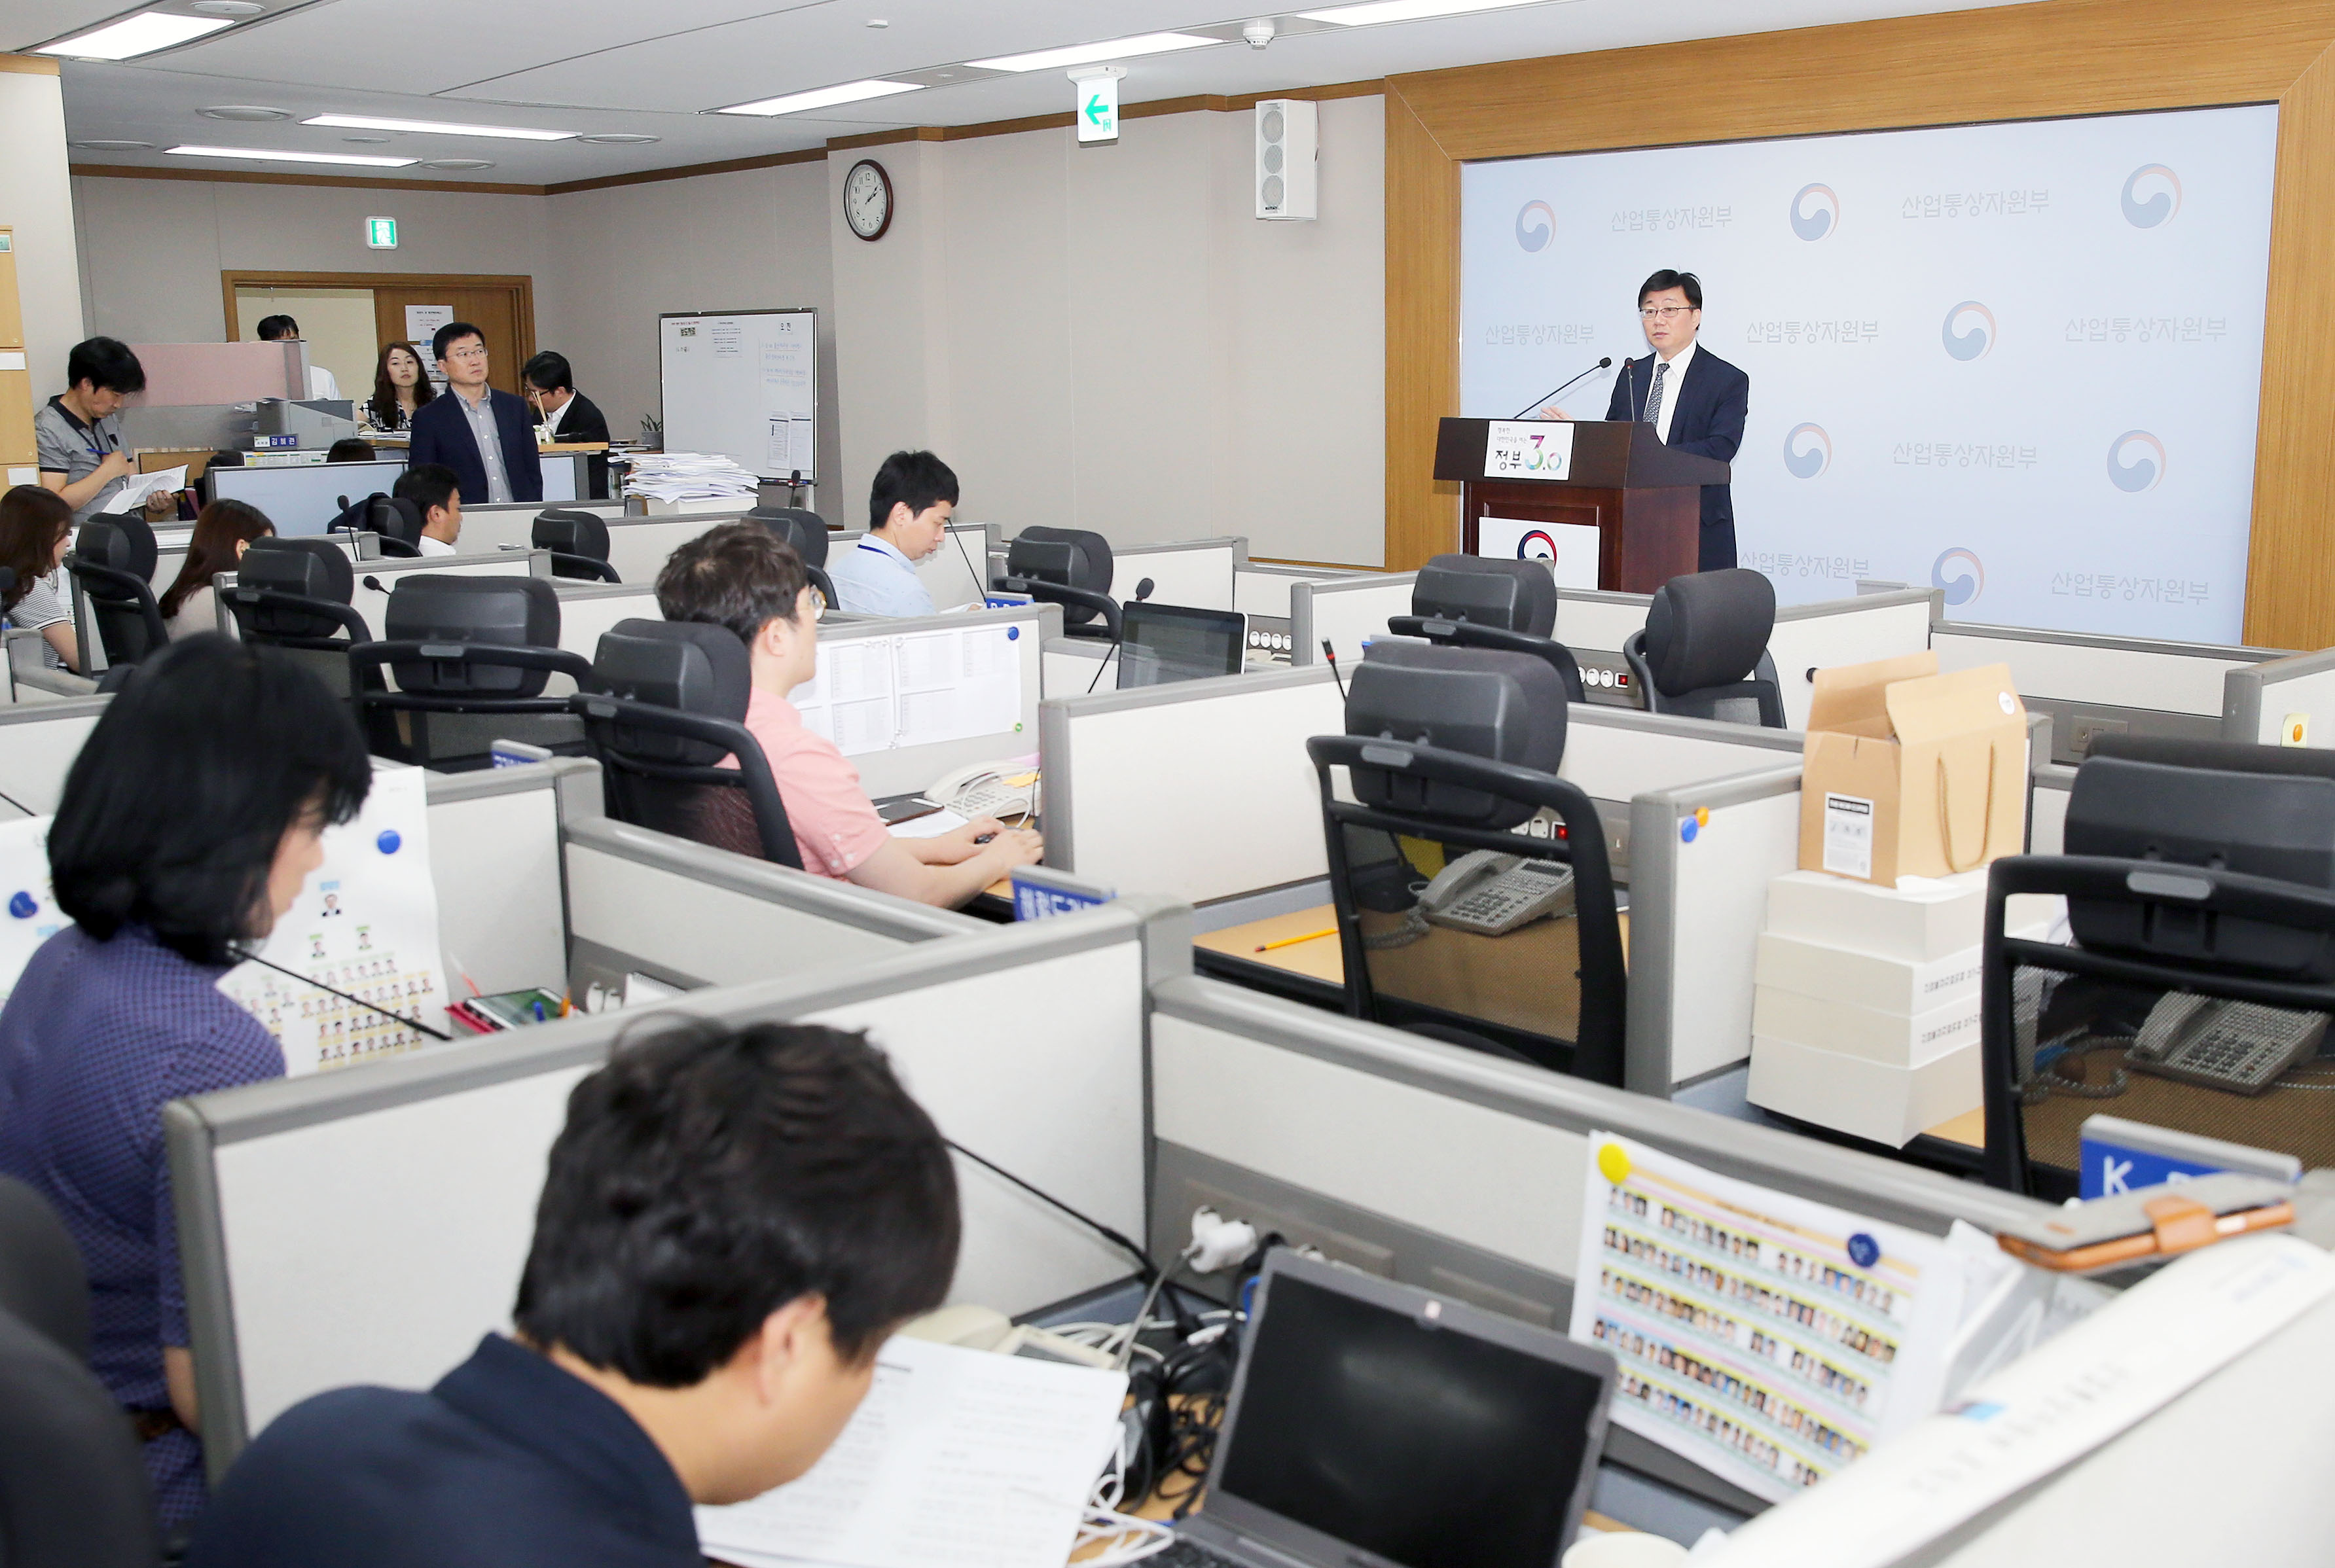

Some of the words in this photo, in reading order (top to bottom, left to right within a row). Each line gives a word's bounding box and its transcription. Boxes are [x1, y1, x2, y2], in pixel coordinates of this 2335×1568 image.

[1901, 188, 2050, 219] 산업통상자원부
[1611, 205, 1733, 232] 산업통상자원부
[1485, 324, 1595, 346] 산업통상자원부
[1746, 320, 1879, 345] 산업통상자원부
[2064, 317, 2227, 344] 산업통상자원부
[1495, 450, 1522, 471] 정부
[1525, 435, 1563, 471] 3.0
[1892, 442, 2038, 470] 산업통상자원부
[1740, 551, 1870, 579] 산업통상자원부
[2050, 571, 2209, 605] 산업통상자원부
